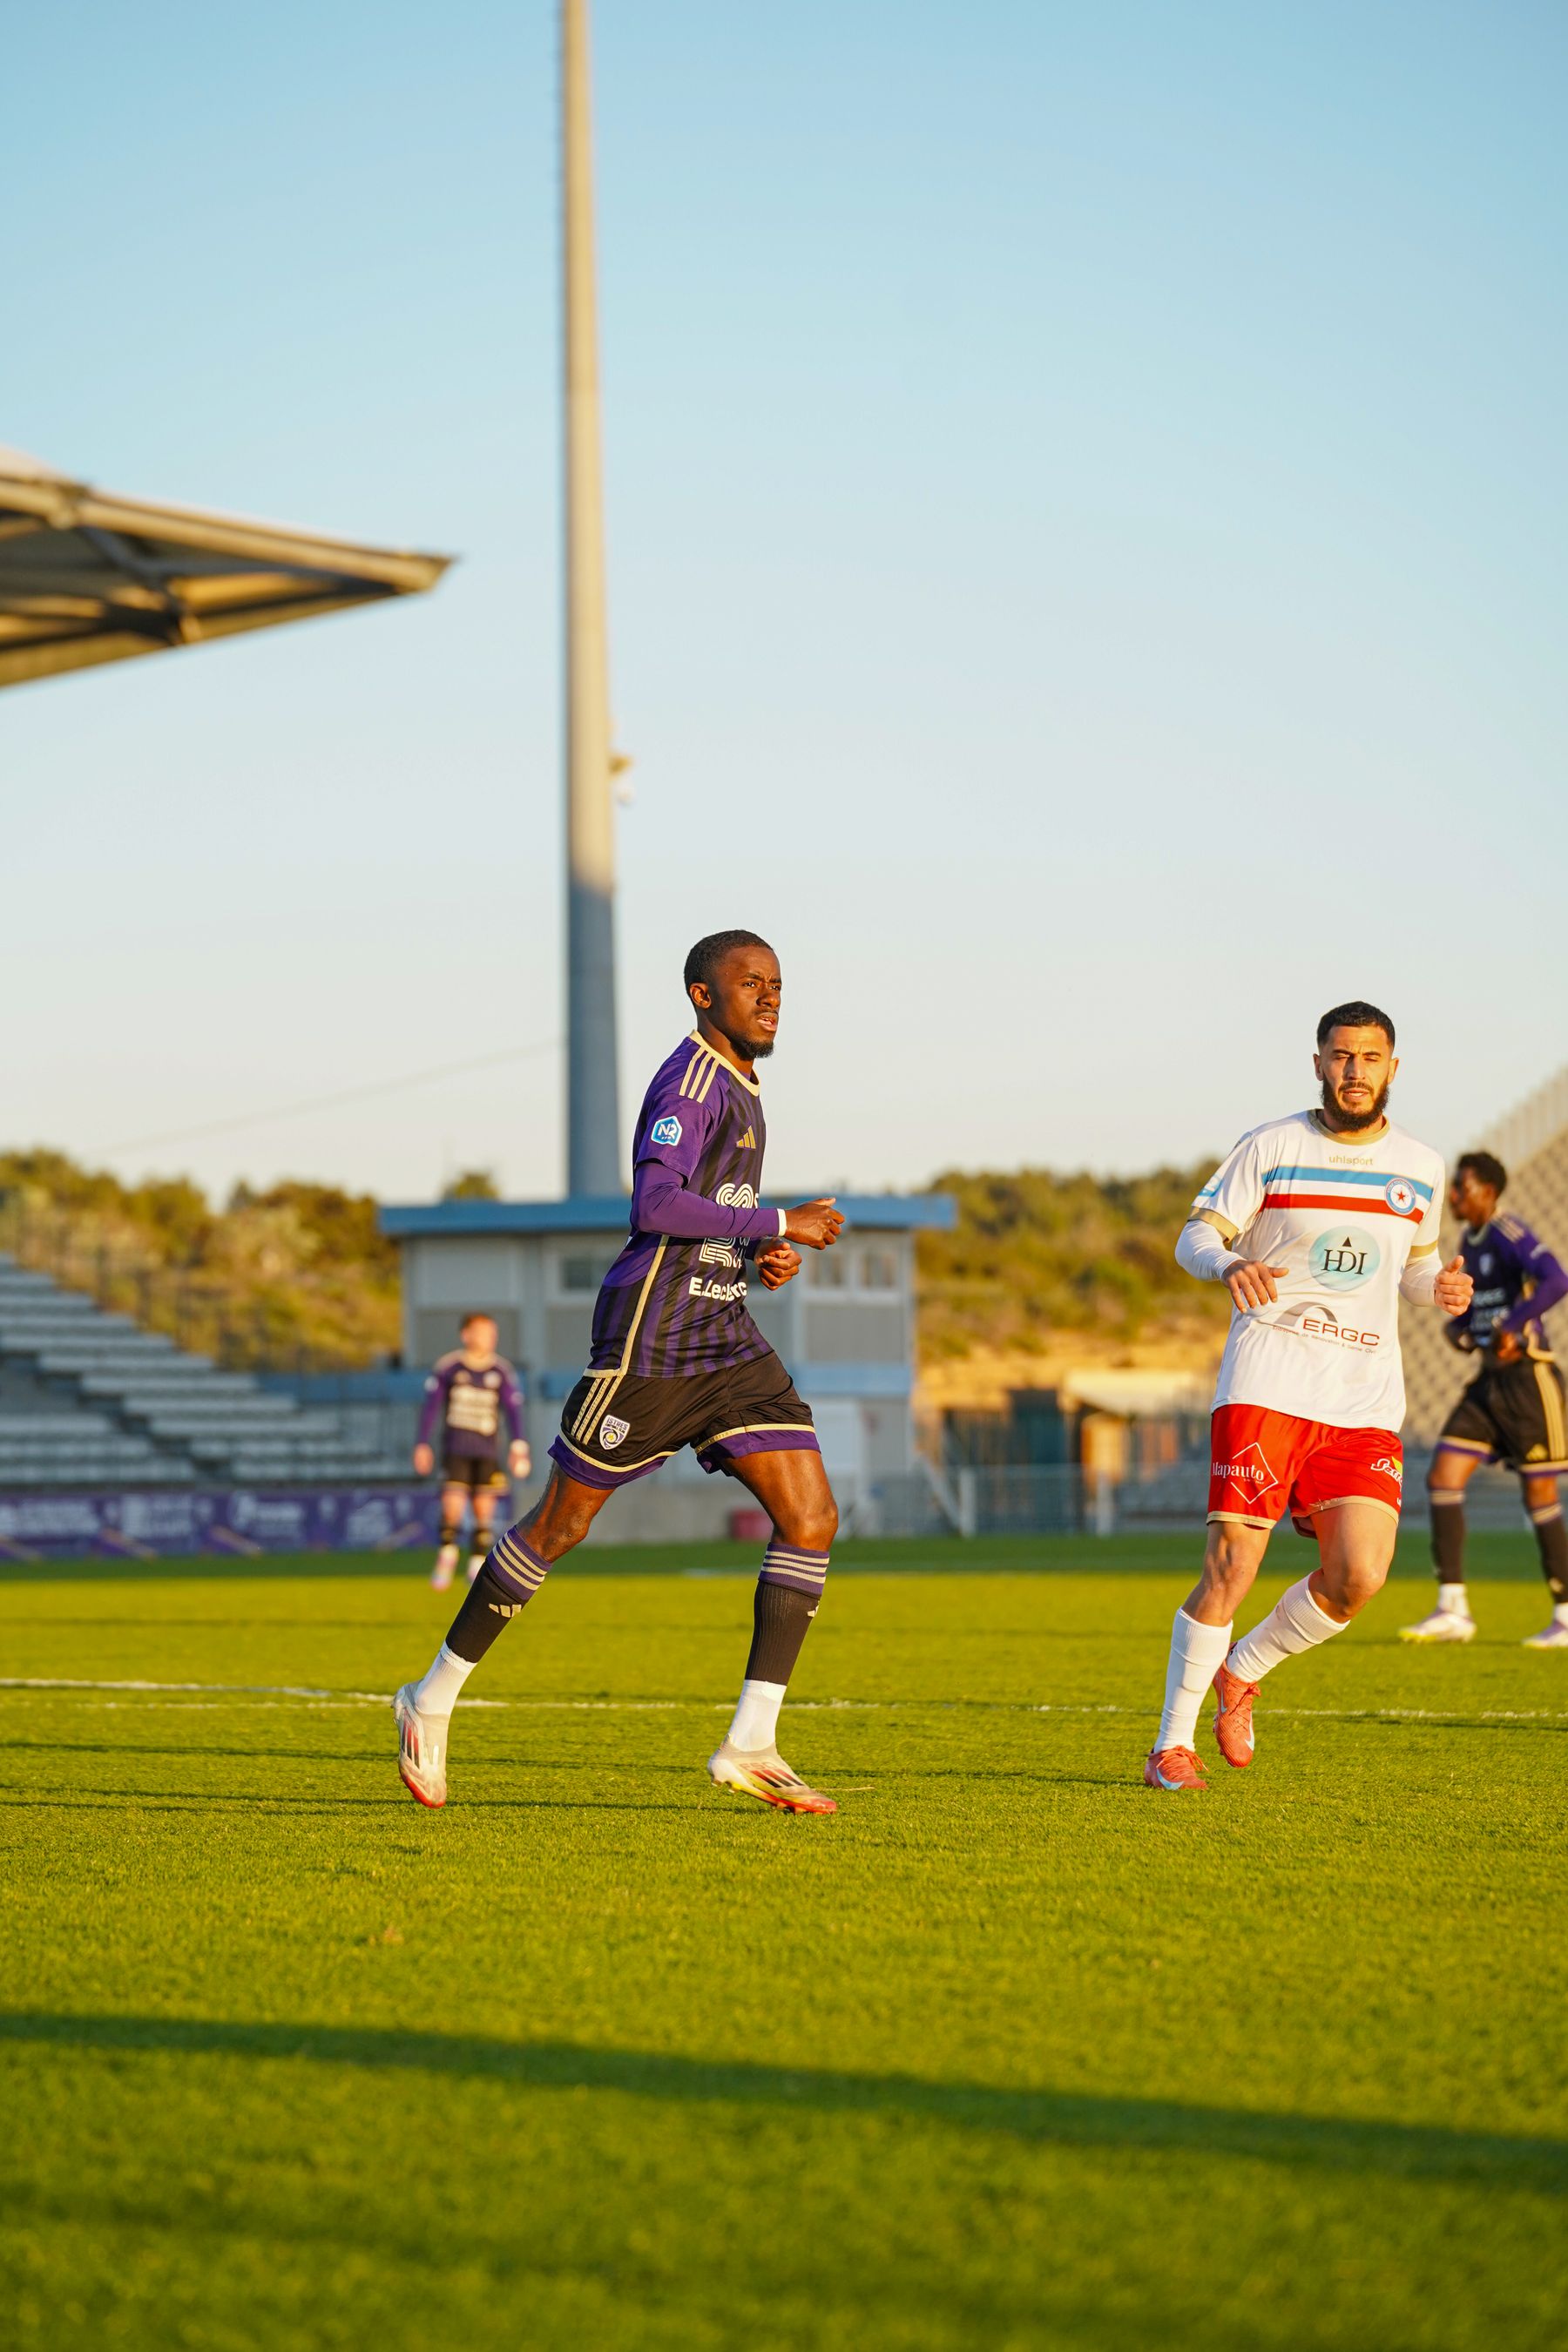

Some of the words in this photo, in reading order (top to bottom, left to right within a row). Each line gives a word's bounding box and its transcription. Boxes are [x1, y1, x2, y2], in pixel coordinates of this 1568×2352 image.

[658, 1124, 677, 1139] N2
[1328, 1155, 1374, 1166] uhlsport
[1321, 1248, 1368, 1274] HDI
[1302, 1318, 1380, 1346] ERGC
[606, 1417, 627, 1429] ISTRES
